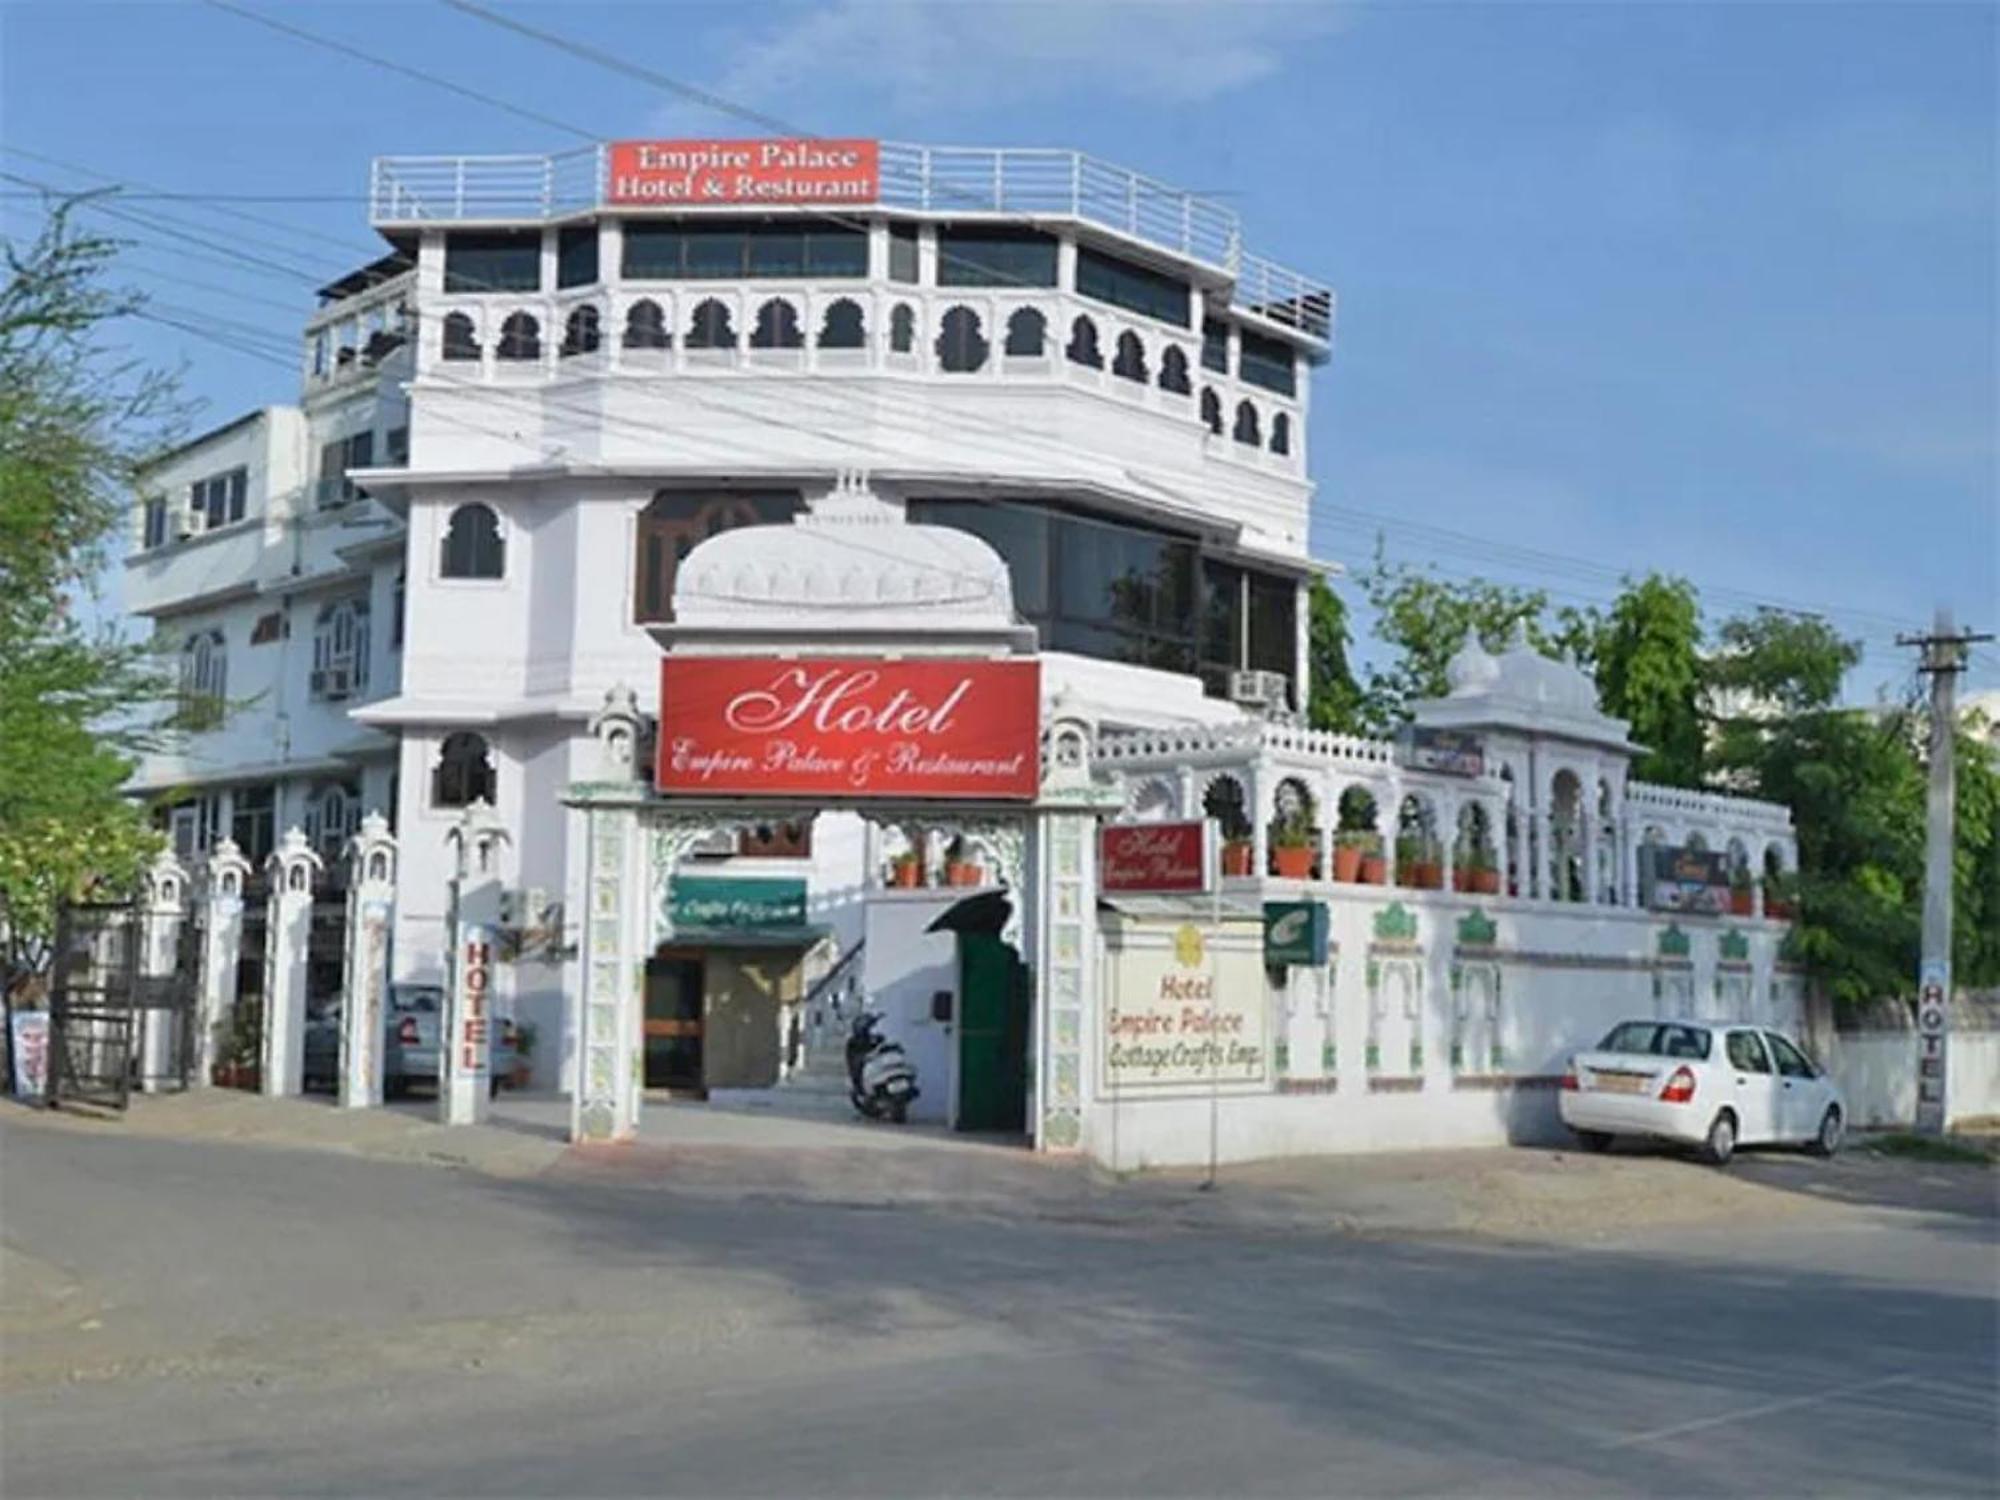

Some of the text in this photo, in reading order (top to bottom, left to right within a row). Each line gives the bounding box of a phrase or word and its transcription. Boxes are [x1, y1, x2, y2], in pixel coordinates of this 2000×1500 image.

[638, 143, 859, 173] Empire Palace
[616, 175, 870, 198] Hotel & Resturant
[725, 666, 974, 735] Hotel
[671, 736, 1025, 786] Empire Palace & Restaurant
[463, 943, 489, 1069] HOTEL
[1160, 975, 1213, 1000] Hotel
[1109, 1006, 1243, 1040] Empire Palace
[1920, 984, 1944, 1103] HOTEL
